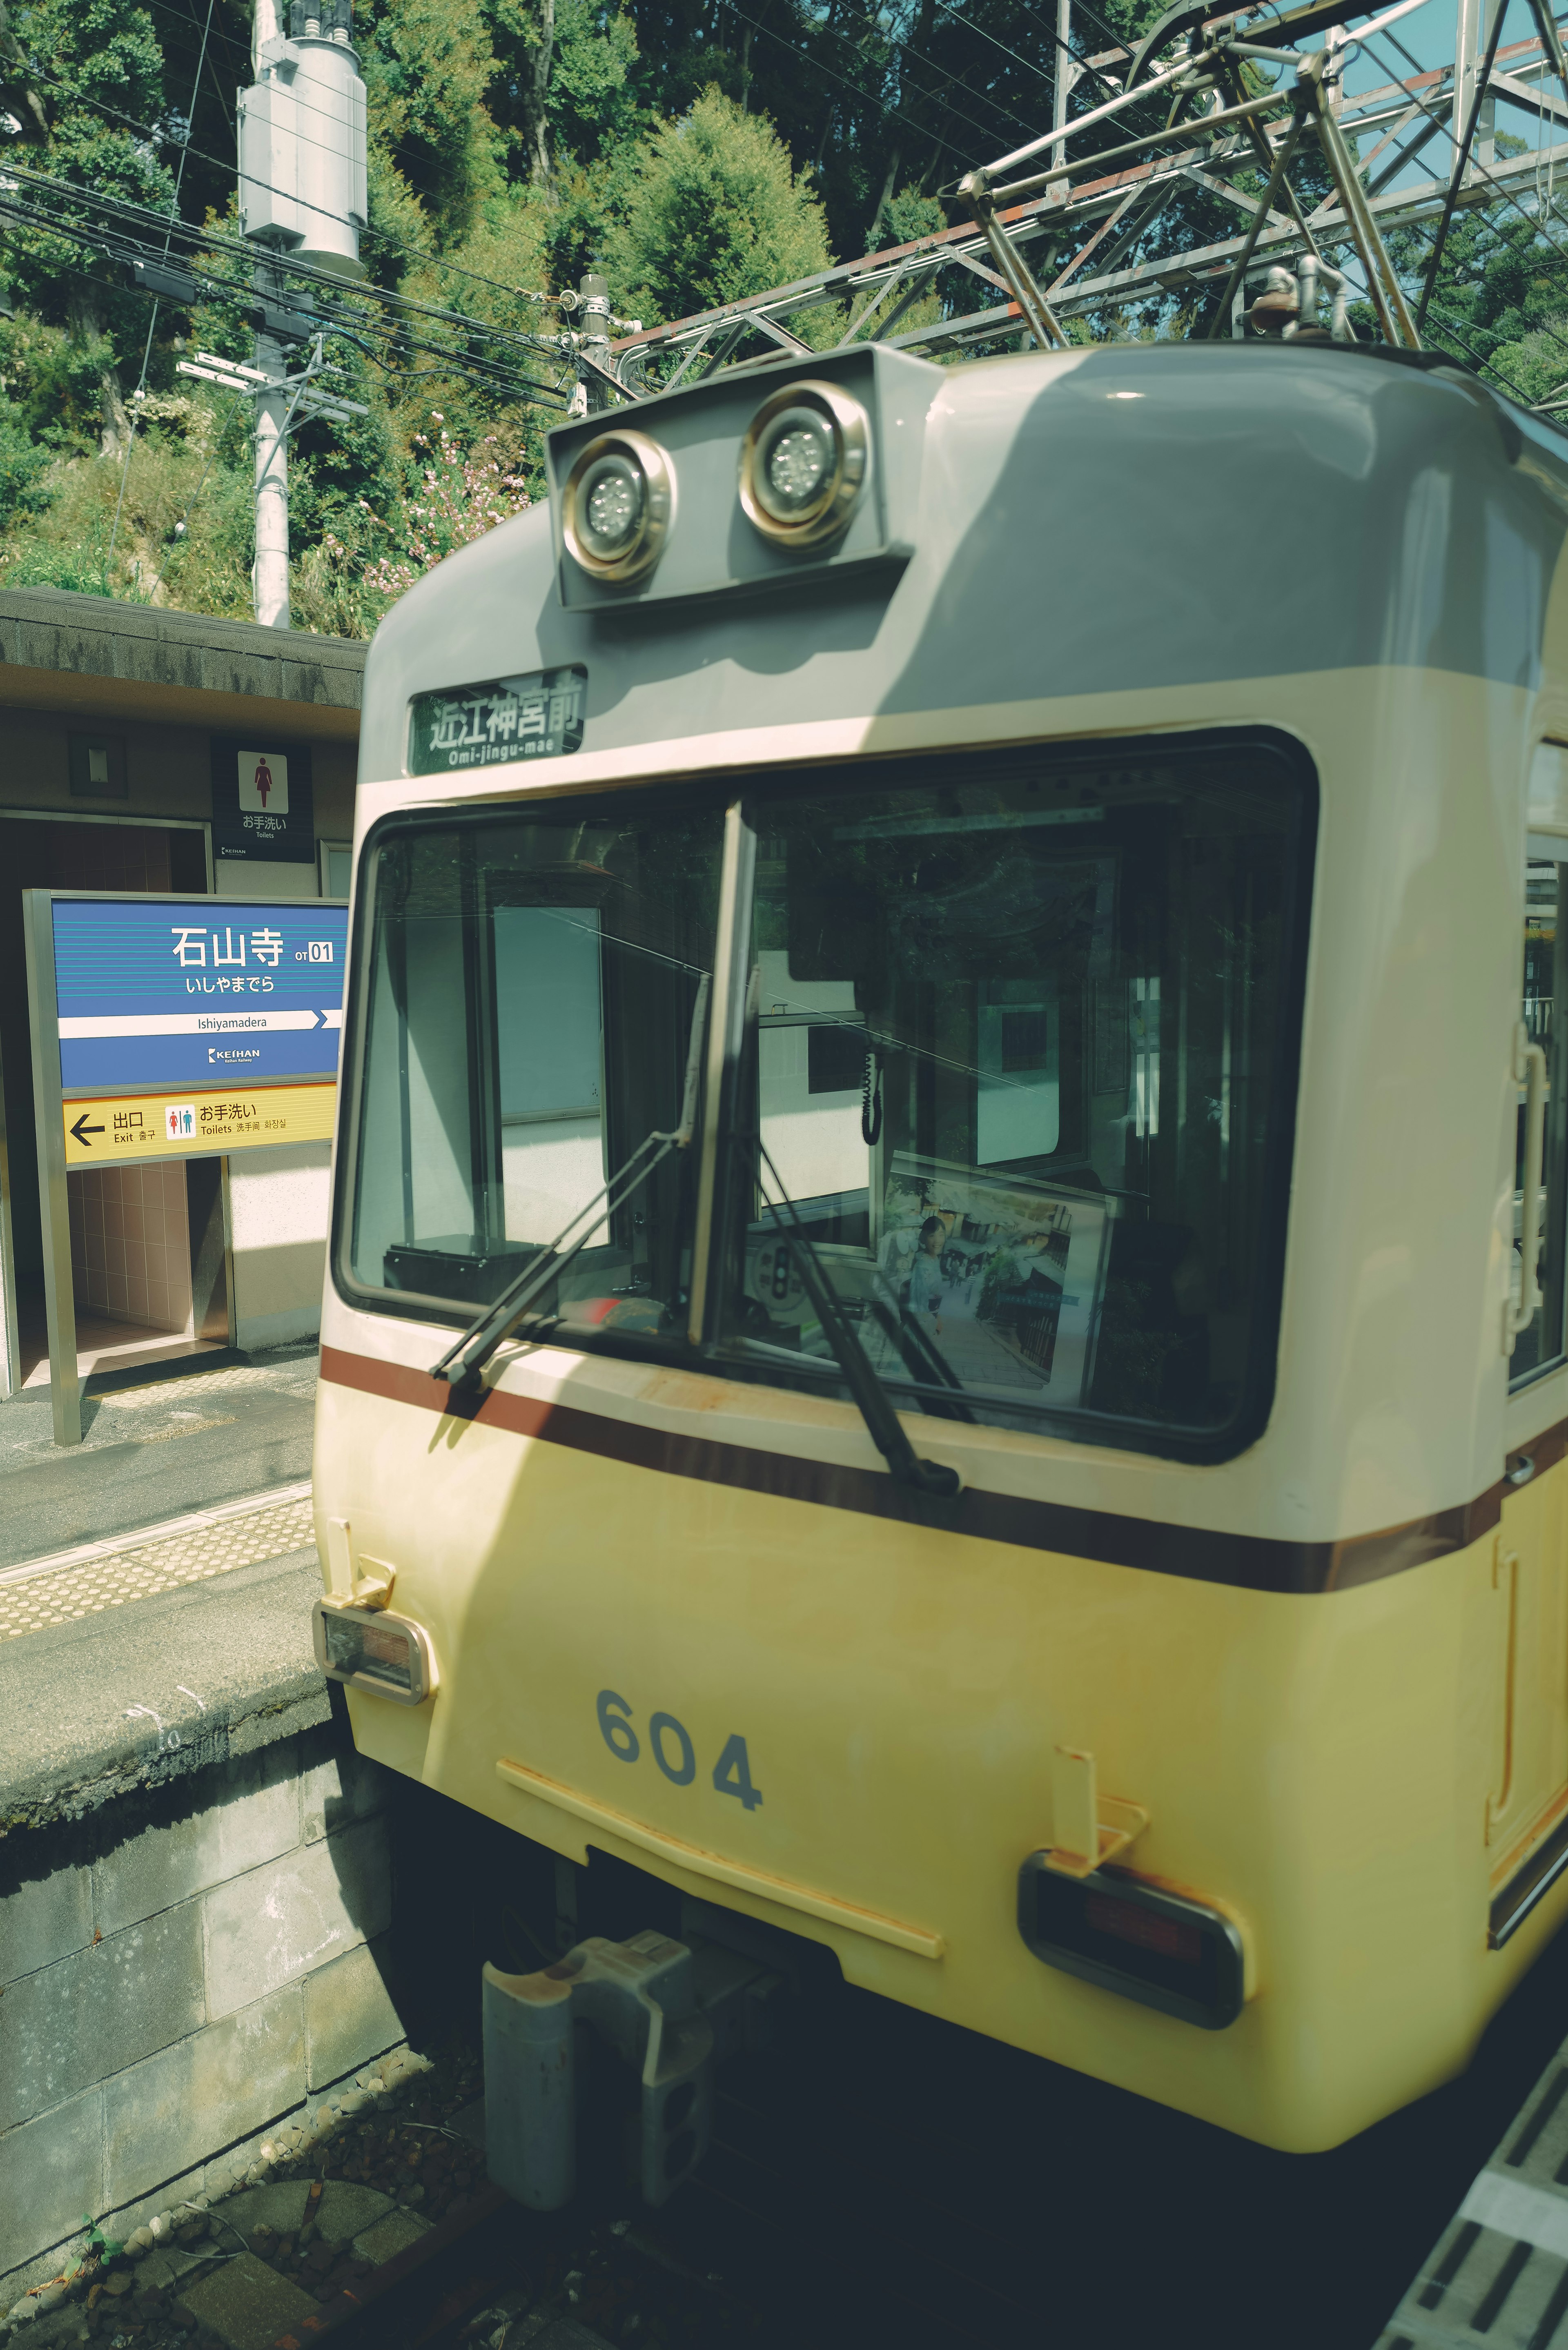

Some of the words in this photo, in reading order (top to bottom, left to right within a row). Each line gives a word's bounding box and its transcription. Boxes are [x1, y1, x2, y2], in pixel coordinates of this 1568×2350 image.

[429, 678, 583, 751] 近江神宮前
[449, 738, 555, 766] Omi-jingu-mae
[243, 815, 286, 830] お手洗い
[171, 927, 283, 967] 石山寺
[294, 951, 308, 961] OT
[311, 943, 331, 961] 01
[186, 976, 274, 993] いしやまでら
[198, 1017, 267, 1031] Ishiyamadera
[216, 1049, 260, 1059] KEIHAN
[114, 1112, 143, 1129] 出口
[200, 1103, 256, 1121] お手洗い
[200, 1125, 232, 1135] Toilets
[236, 1122, 260, 1132] 洗手间
[264, 1119, 286, 1129] 화장실
[114, 1133, 134, 1143] Exit
[138, 1130, 156, 1140] 출구
[596, 1689, 764, 1812] 604
